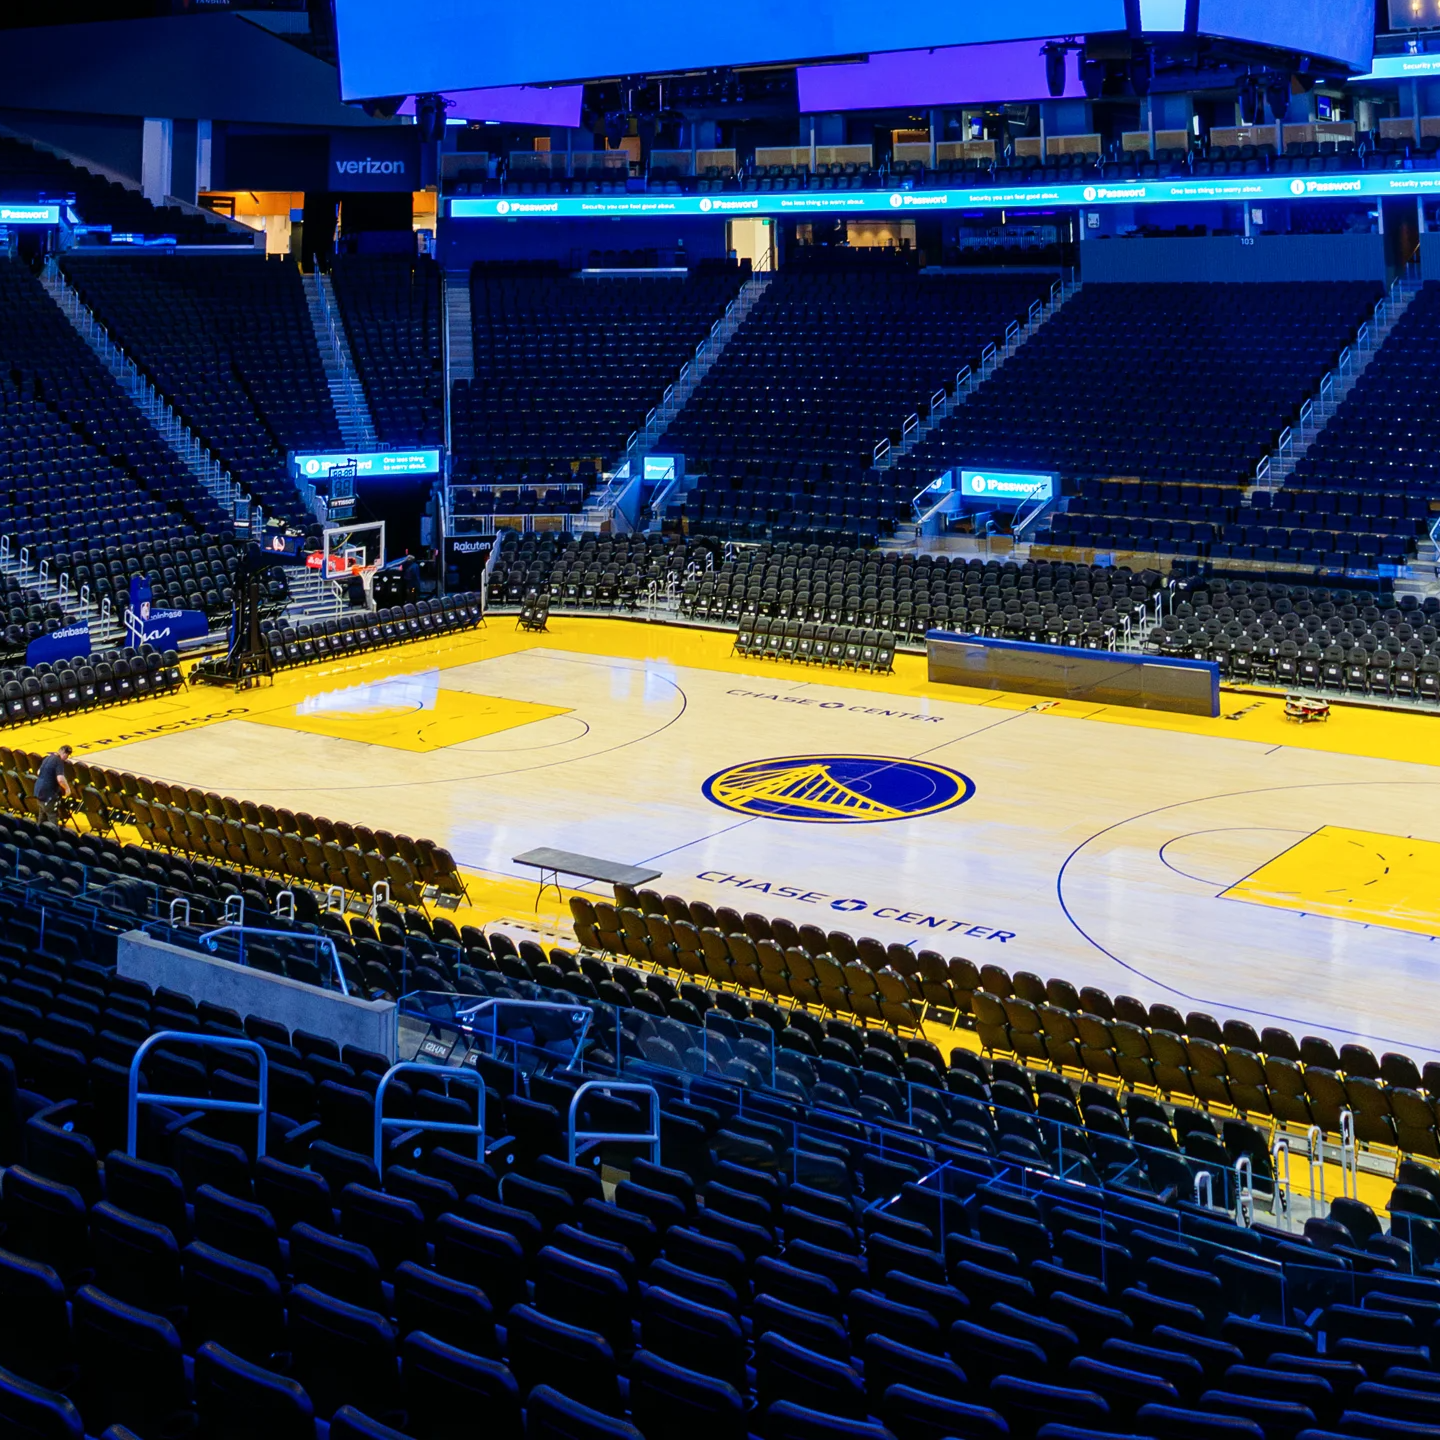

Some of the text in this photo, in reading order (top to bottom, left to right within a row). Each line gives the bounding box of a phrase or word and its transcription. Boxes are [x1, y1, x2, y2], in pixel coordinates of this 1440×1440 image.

[1402, 61, 1430, 70] Security
[335, 156, 405, 175] verizon
[1306, 178, 1361, 192] 1Password
[1390, 179, 1418, 187] Security
[0, 210, 49, 220] 1Password
[453, 541, 491, 552] Rakuten
[52, 627, 89, 639] coinbase
[726, 689, 945, 723] CHASE CENTER
[696, 870, 1017, 944] CHASE CENTER
